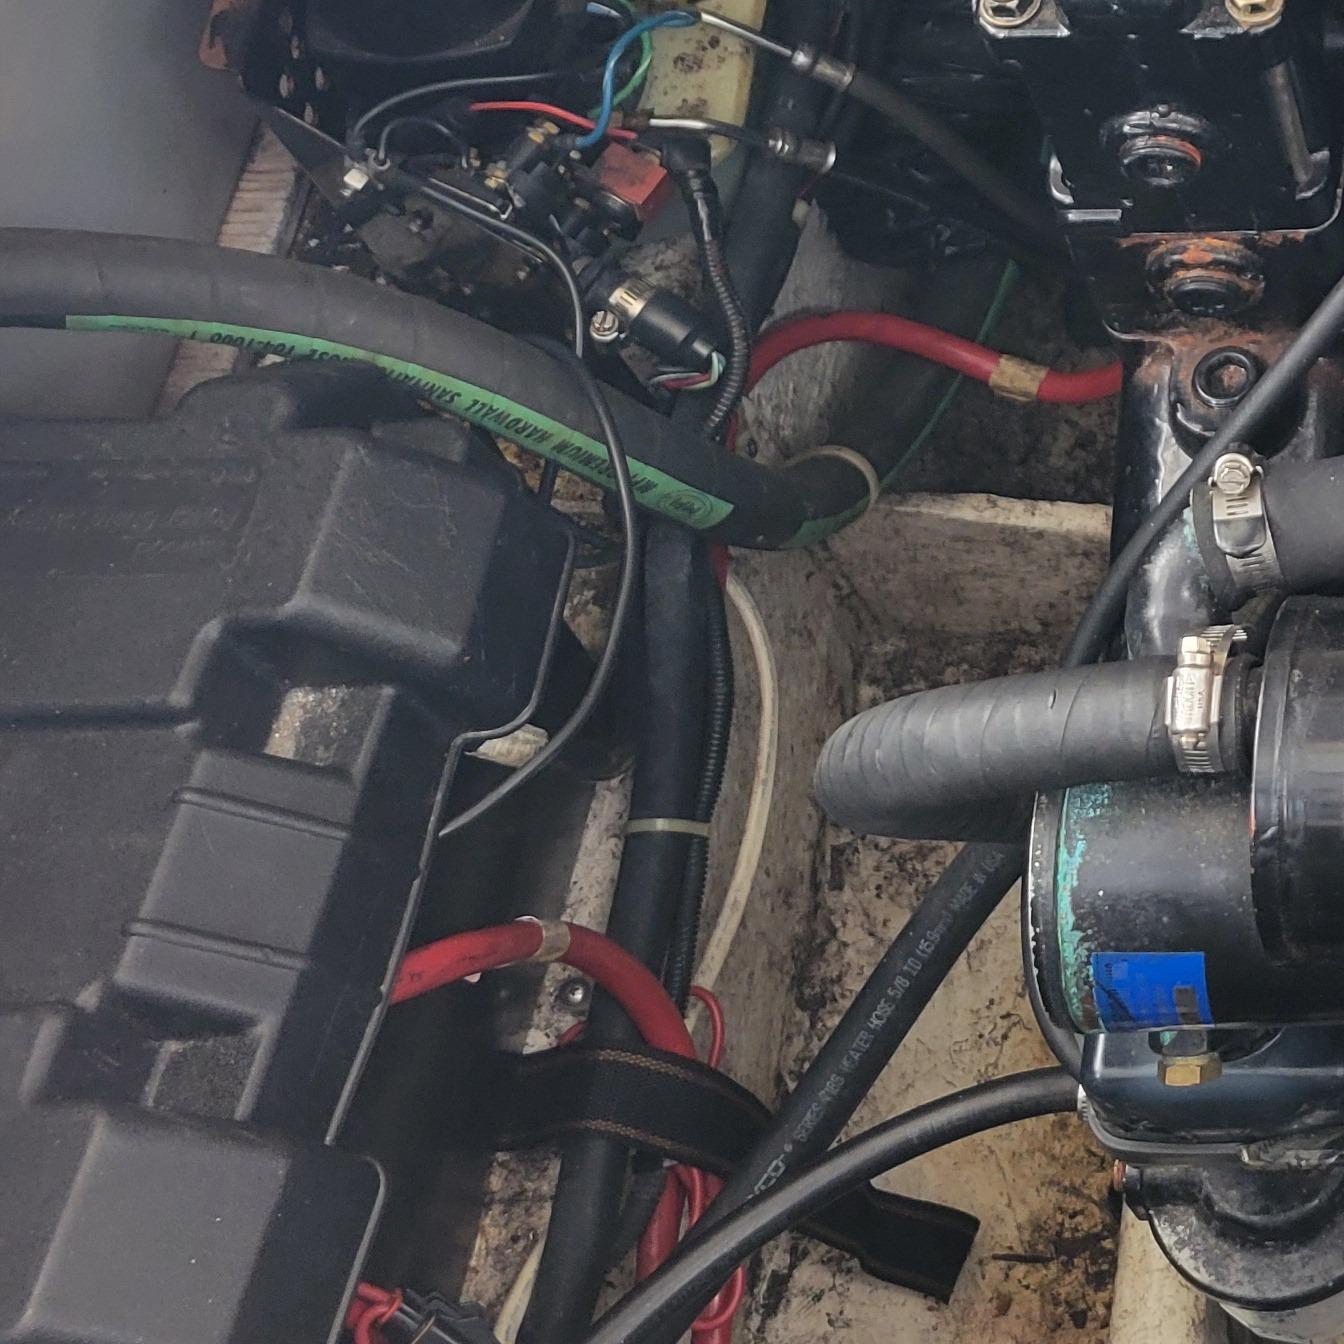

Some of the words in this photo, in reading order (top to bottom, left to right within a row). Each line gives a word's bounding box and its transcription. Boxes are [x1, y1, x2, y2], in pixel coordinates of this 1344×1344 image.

[468, 398, 554, 444] HARDWALL
[867, 997, 896, 1033] HOSE
[887, 975, 911, 1000] 5/8
[951, 882, 980, 913] MADE
